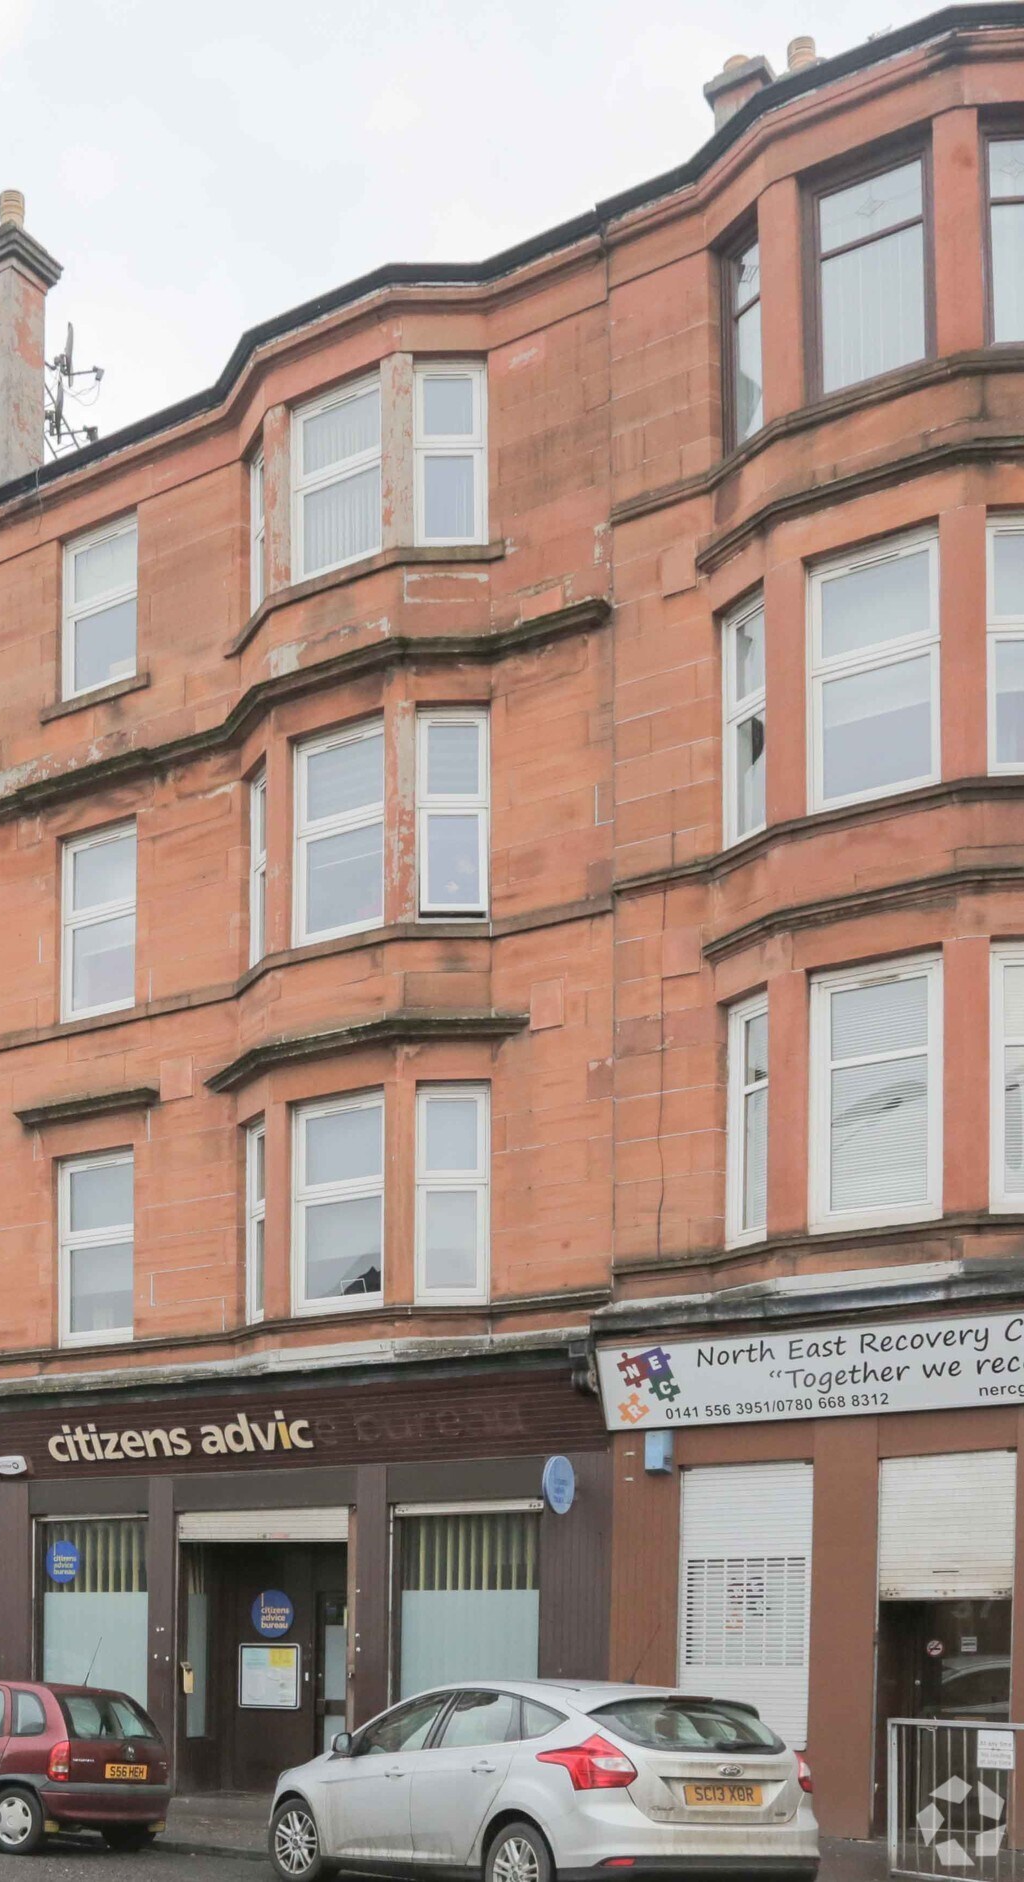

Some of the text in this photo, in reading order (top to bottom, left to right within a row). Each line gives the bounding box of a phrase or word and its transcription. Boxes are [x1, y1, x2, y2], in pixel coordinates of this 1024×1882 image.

[696, 1337, 775, 1368] North
[788, 1336, 847, 1360] East
[859, 1328, 989, 1353] Recovery
[923, 1361, 963, 1379] we
[976, 1355, 1024, 1375] rec
[665, 1392, 889, 1420] 0141 556 3951/0780 668 8312
[47, 1424, 191, 1462] citizens
[260, 1614, 286, 1622] advice
[260, 1621, 288, 1629] bureau
[110, 1766, 144, 1778] S56 HEH
[694, 1786, 725, 1801] SC13
